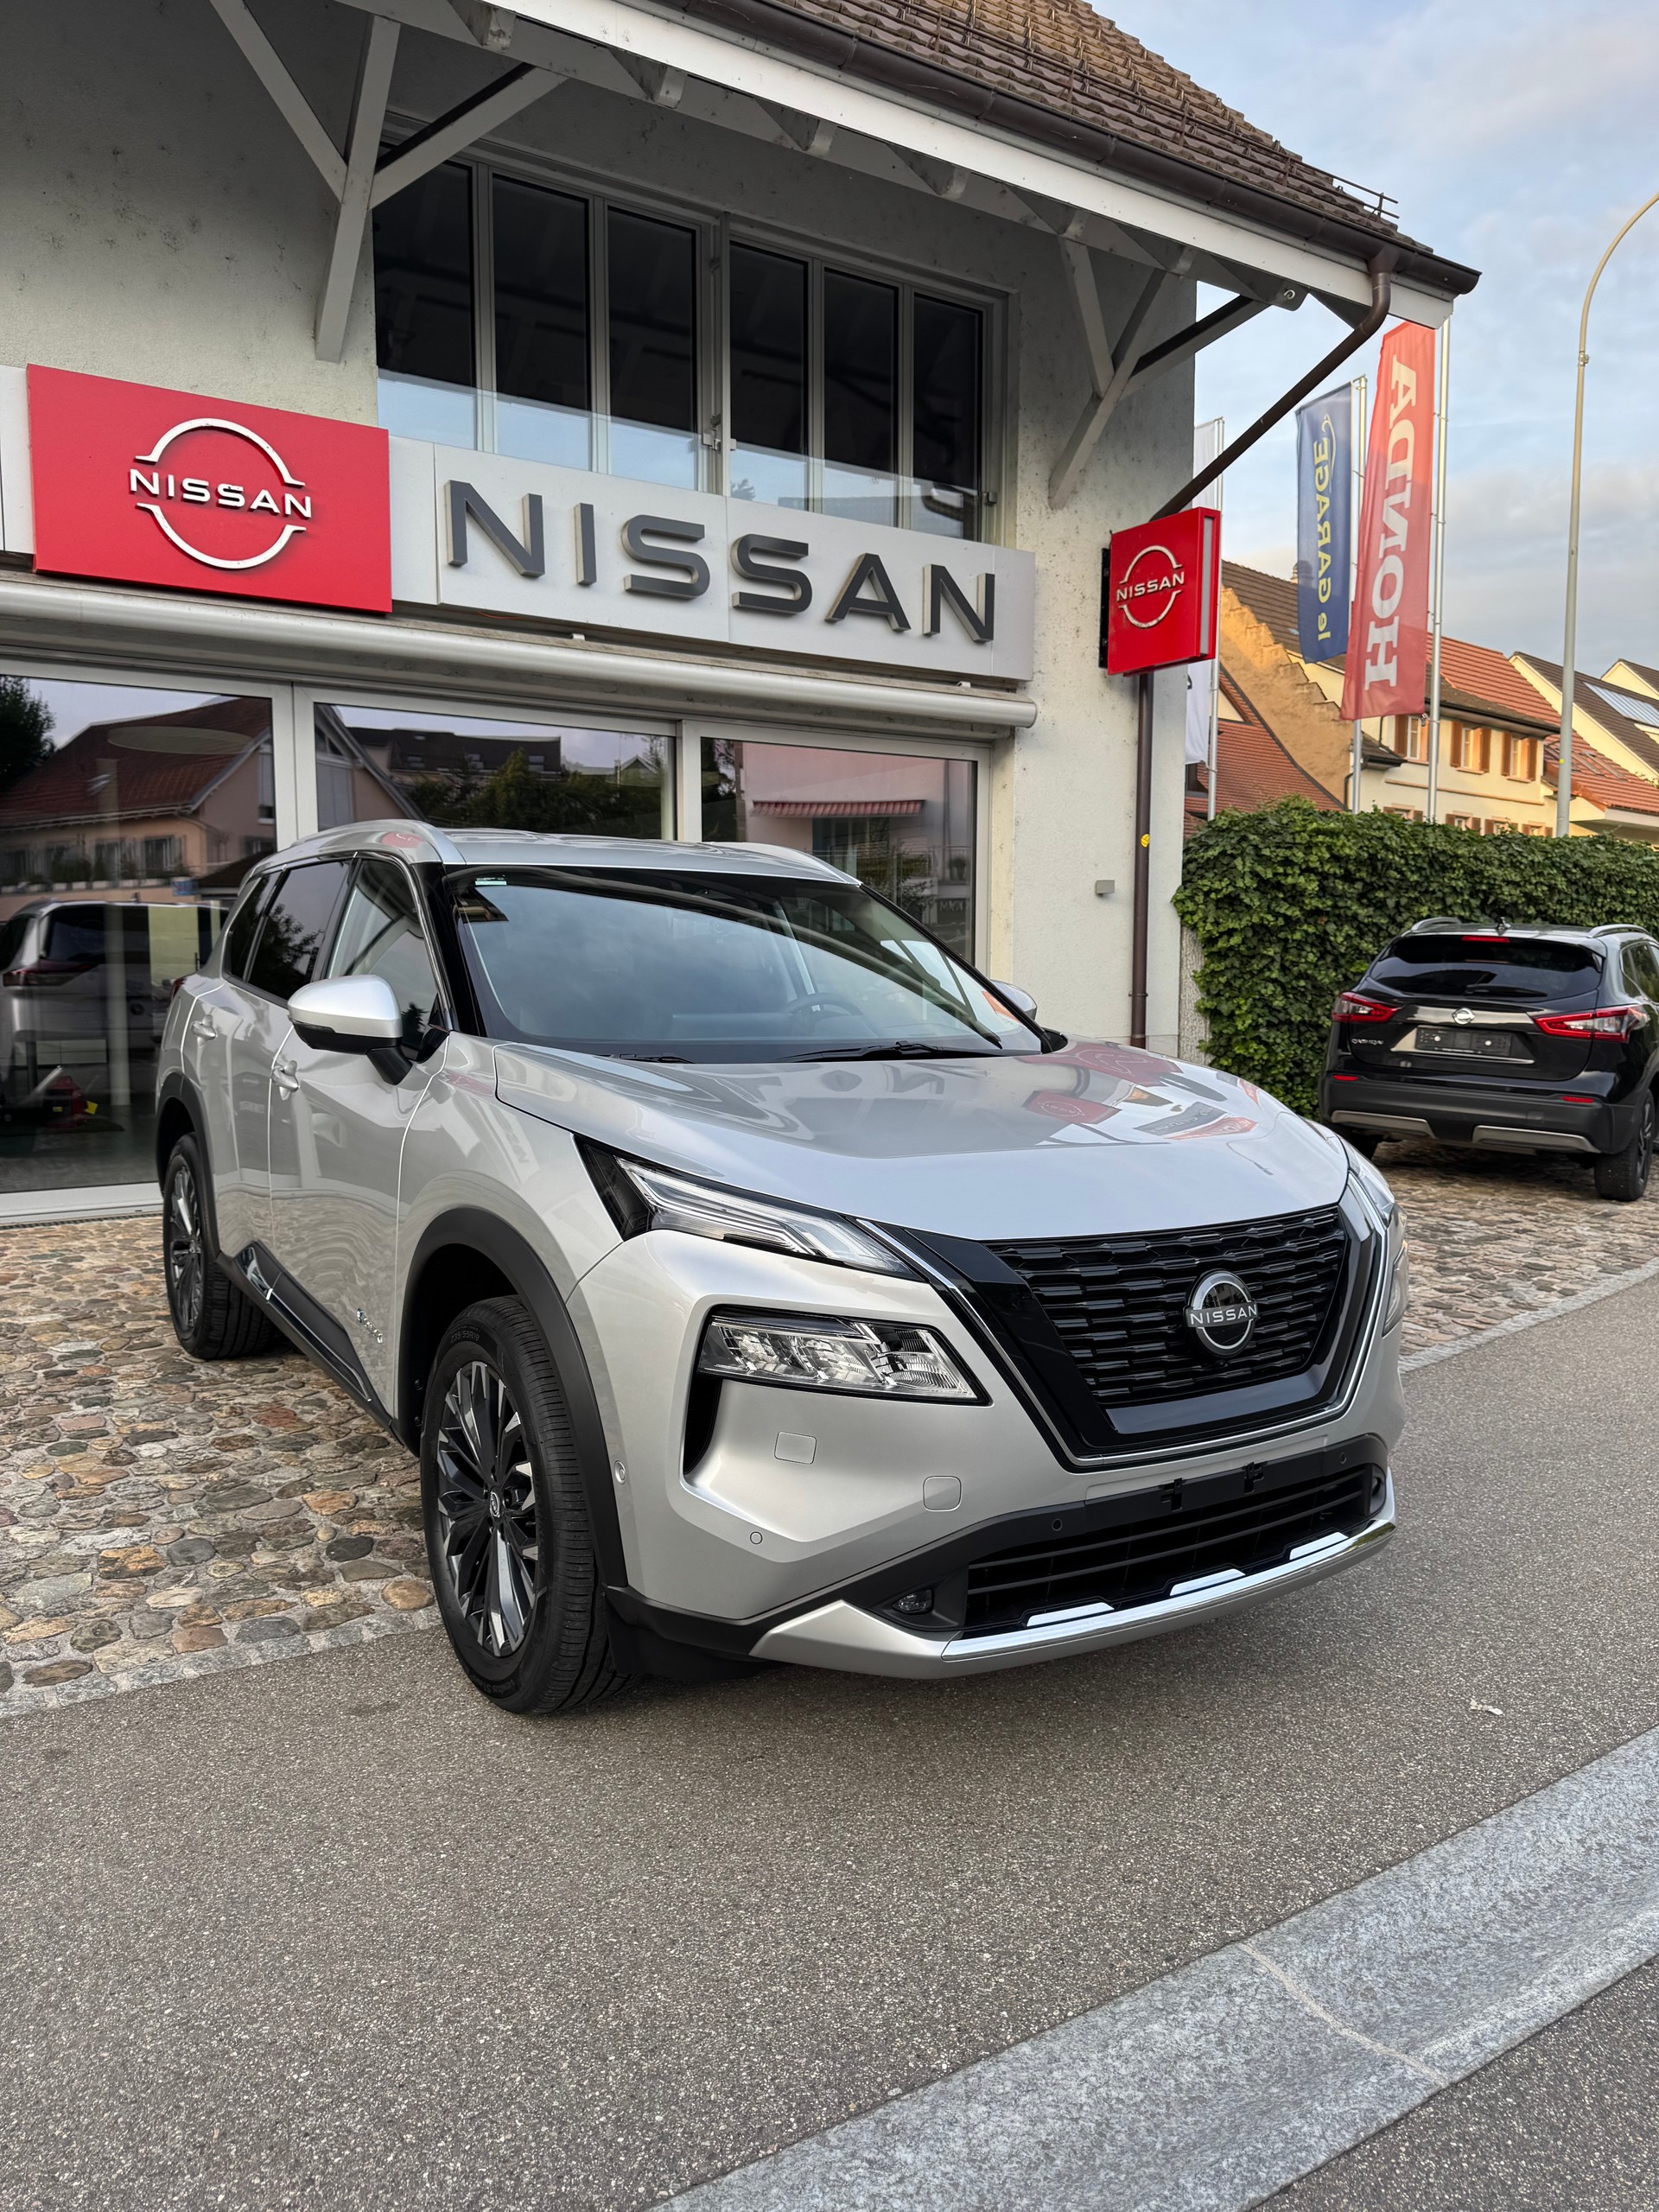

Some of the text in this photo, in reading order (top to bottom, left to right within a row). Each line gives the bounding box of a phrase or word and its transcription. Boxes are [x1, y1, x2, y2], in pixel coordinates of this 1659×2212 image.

[130, 468, 312, 518] NISSAN
[445, 480, 995, 643] NISSAN
[1116, 571, 1185, 601] NISSAN
[1190, 1304, 1257, 1325] NISSAN
